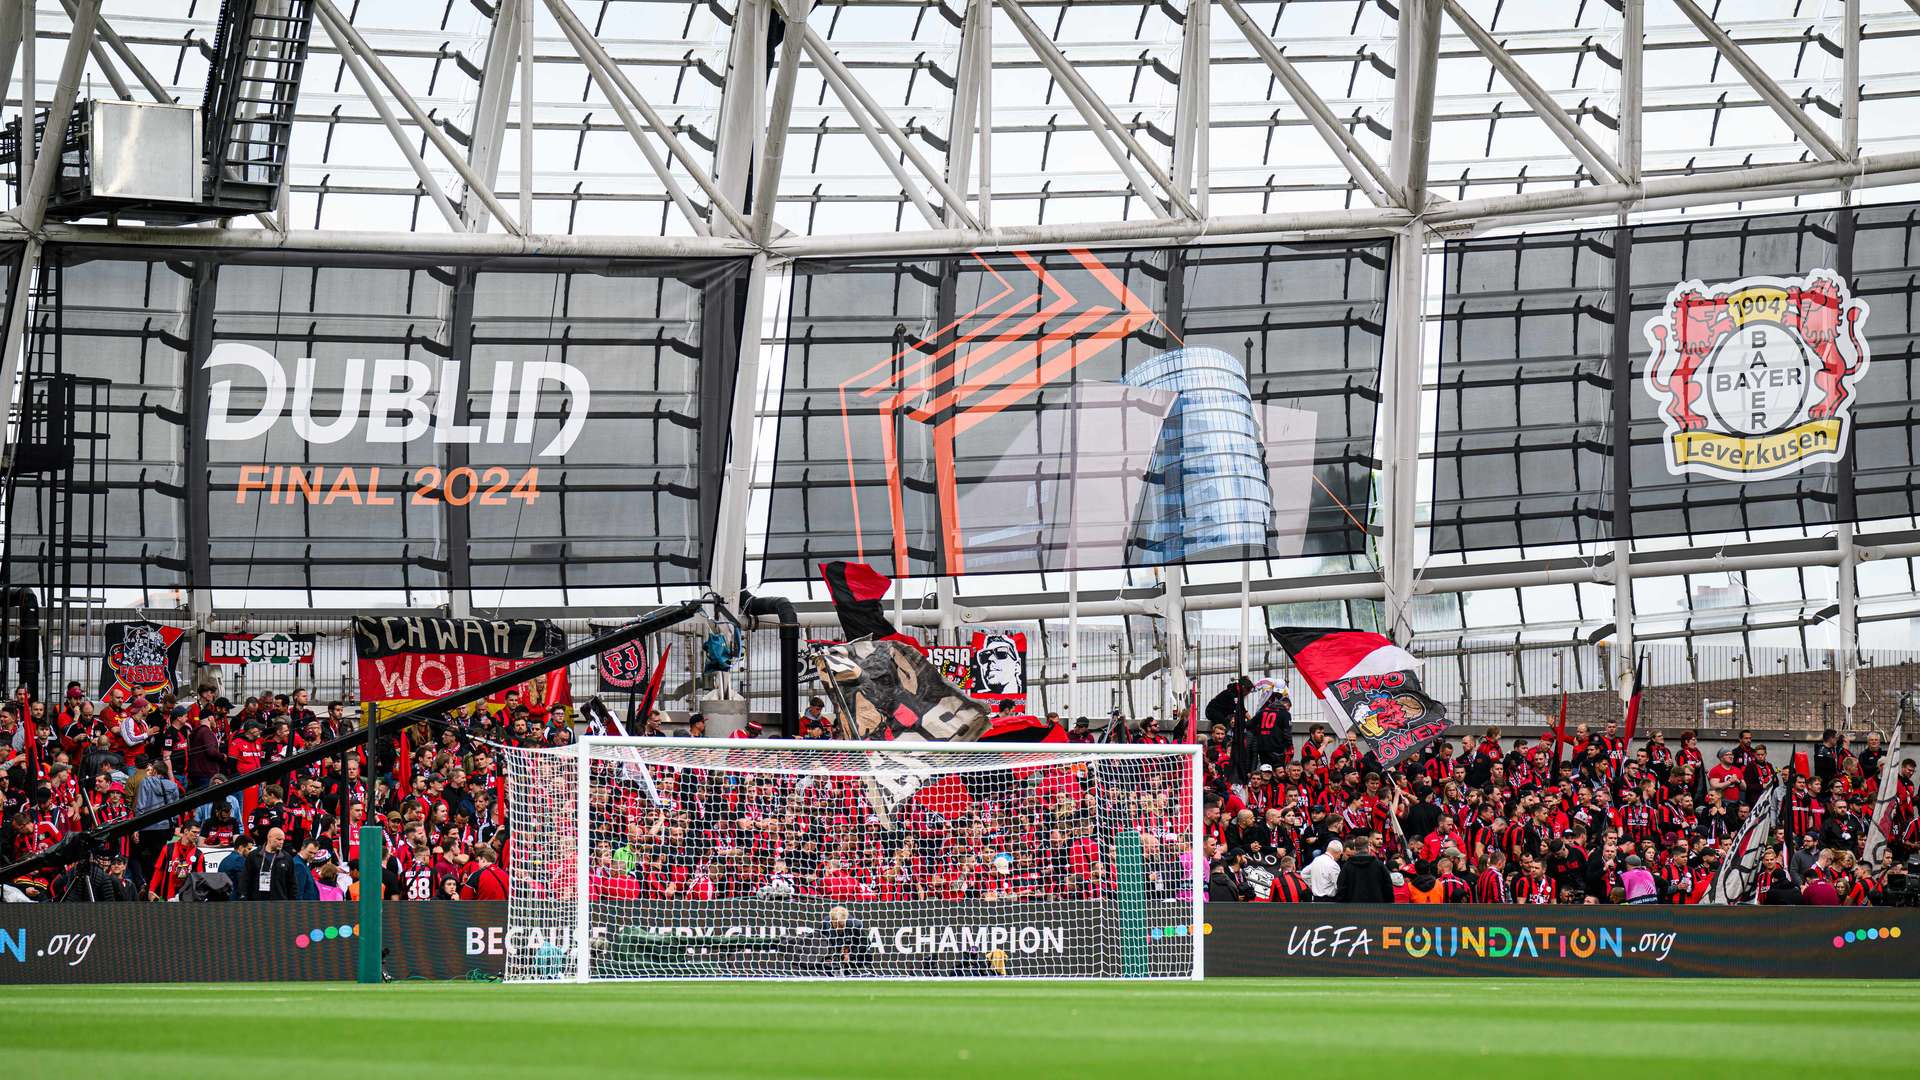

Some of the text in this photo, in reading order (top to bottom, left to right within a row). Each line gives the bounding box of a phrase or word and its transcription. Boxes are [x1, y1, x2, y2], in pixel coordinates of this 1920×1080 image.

[1733, 294, 1781, 318] 1904
[1716, 367, 1802, 392] BAYER
[1751, 331, 1768, 429] BAYER
[201, 343, 591, 456] DUBLIN
[1687, 429, 1828, 466] Leverkusen
[235, 464, 541, 506] FINAL 2024
[355, 616, 545, 659] SCHWARZ
[605, 646, 639, 676] FJ
[1336, 671, 1405, 700] PIWO
[1260, 711, 1277, 729] 10
[1372, 719, 1449, 764] LÖWEN
[406, 877, 431, 899] 38
[37, 933, 96, 966] .org
[466, 927, 607, 955] BECAU
[868, 927, 885, 954] A
[895, 926, 1065, 955] CHAMPION
[1287, 925, 1677, 961] UEFA FOUNDATION .org
